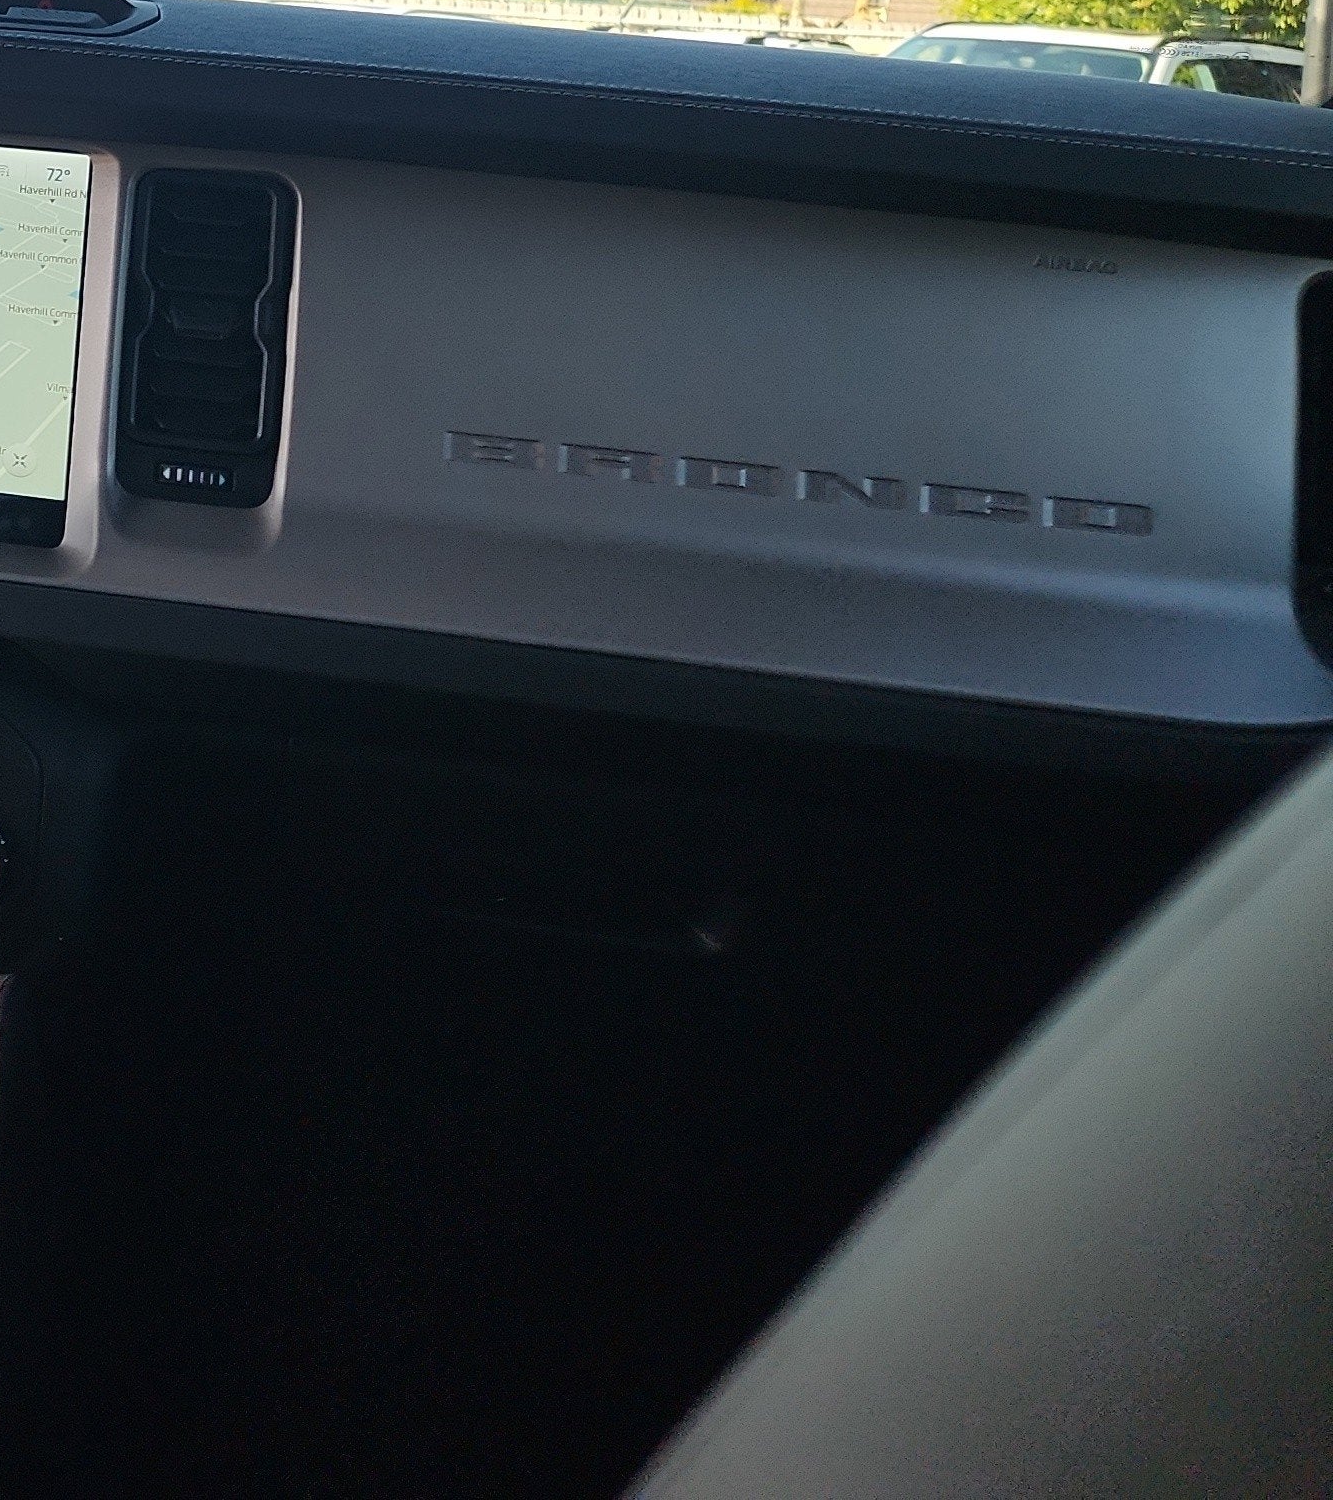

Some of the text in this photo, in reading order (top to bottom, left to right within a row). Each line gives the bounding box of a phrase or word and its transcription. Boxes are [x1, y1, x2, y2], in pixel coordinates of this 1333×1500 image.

[46, 167, 71, 182] 72°
[19, 184, 62, 197] Haverhill
[64, 188, 78, 199] Rd
[18, 223, 58, 235] Haverhill
[37, 252, 78, 265] Common
[8, 303, 48, 317] Haverhill
[442, 429, 1155, 537] BRONCO
